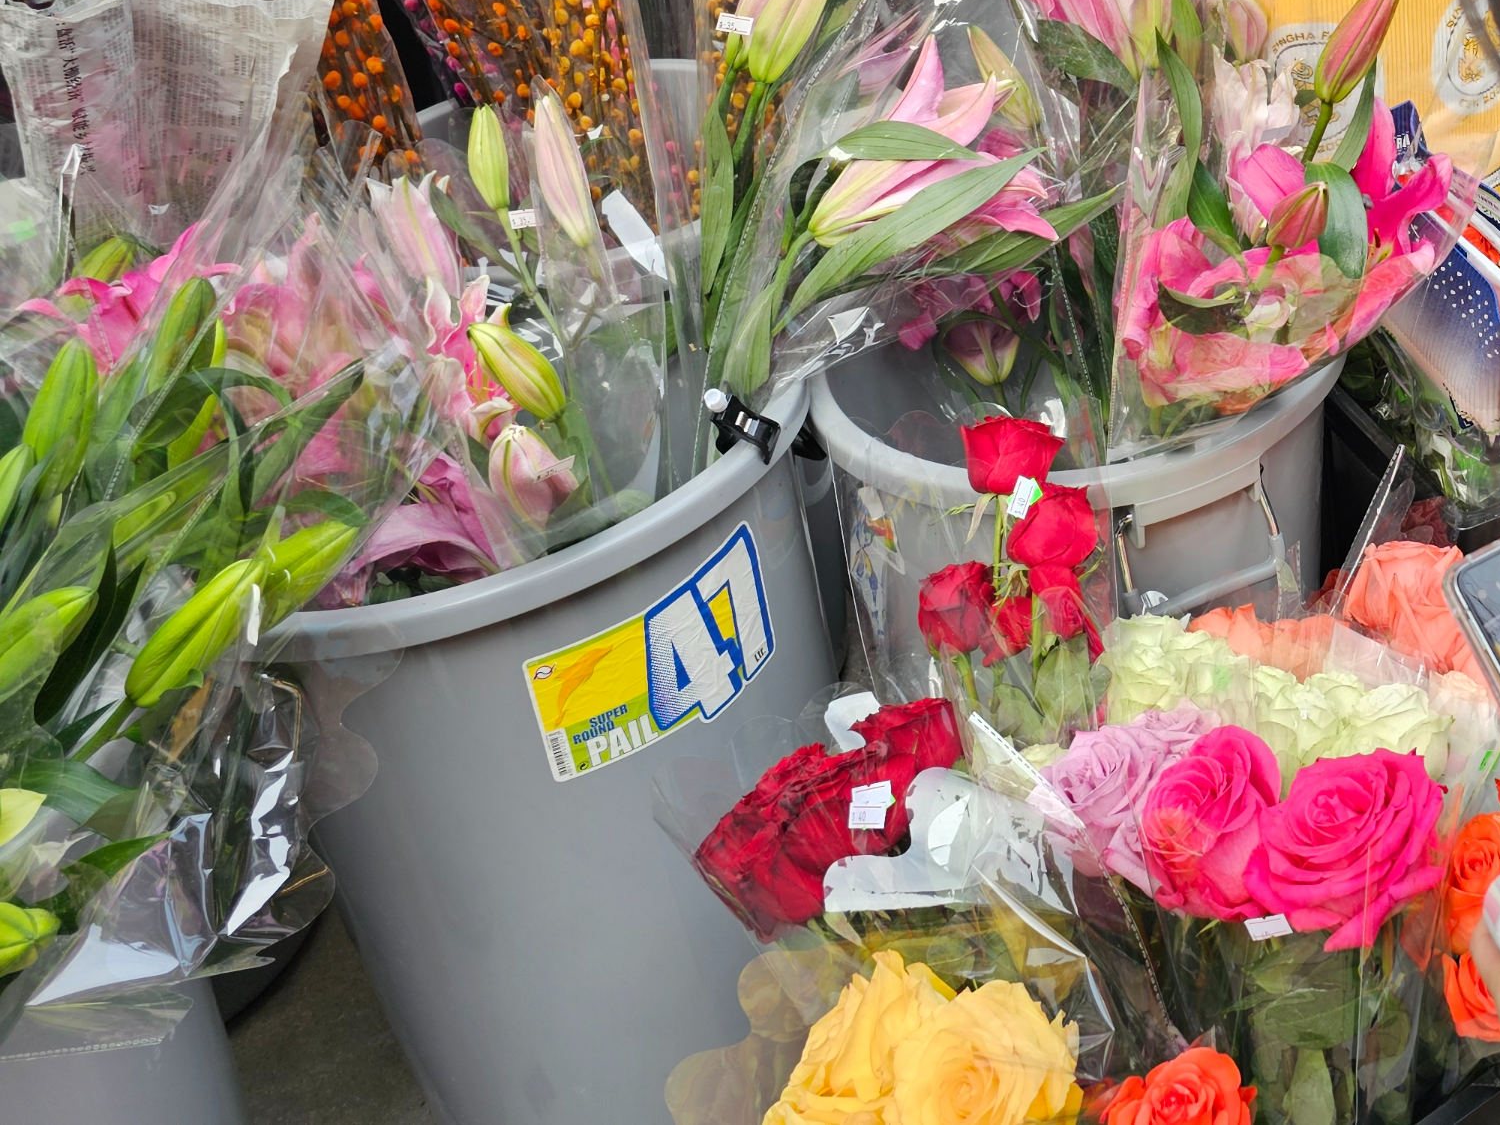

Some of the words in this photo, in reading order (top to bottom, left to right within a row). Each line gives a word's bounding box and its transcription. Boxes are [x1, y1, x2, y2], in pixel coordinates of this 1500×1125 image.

[646, 529, 772, 727] 47
[572, 720, 616, 746] ROUND
[589, 703, 629, 728] SUPER
[585, 713, 660, 768] PAIL
